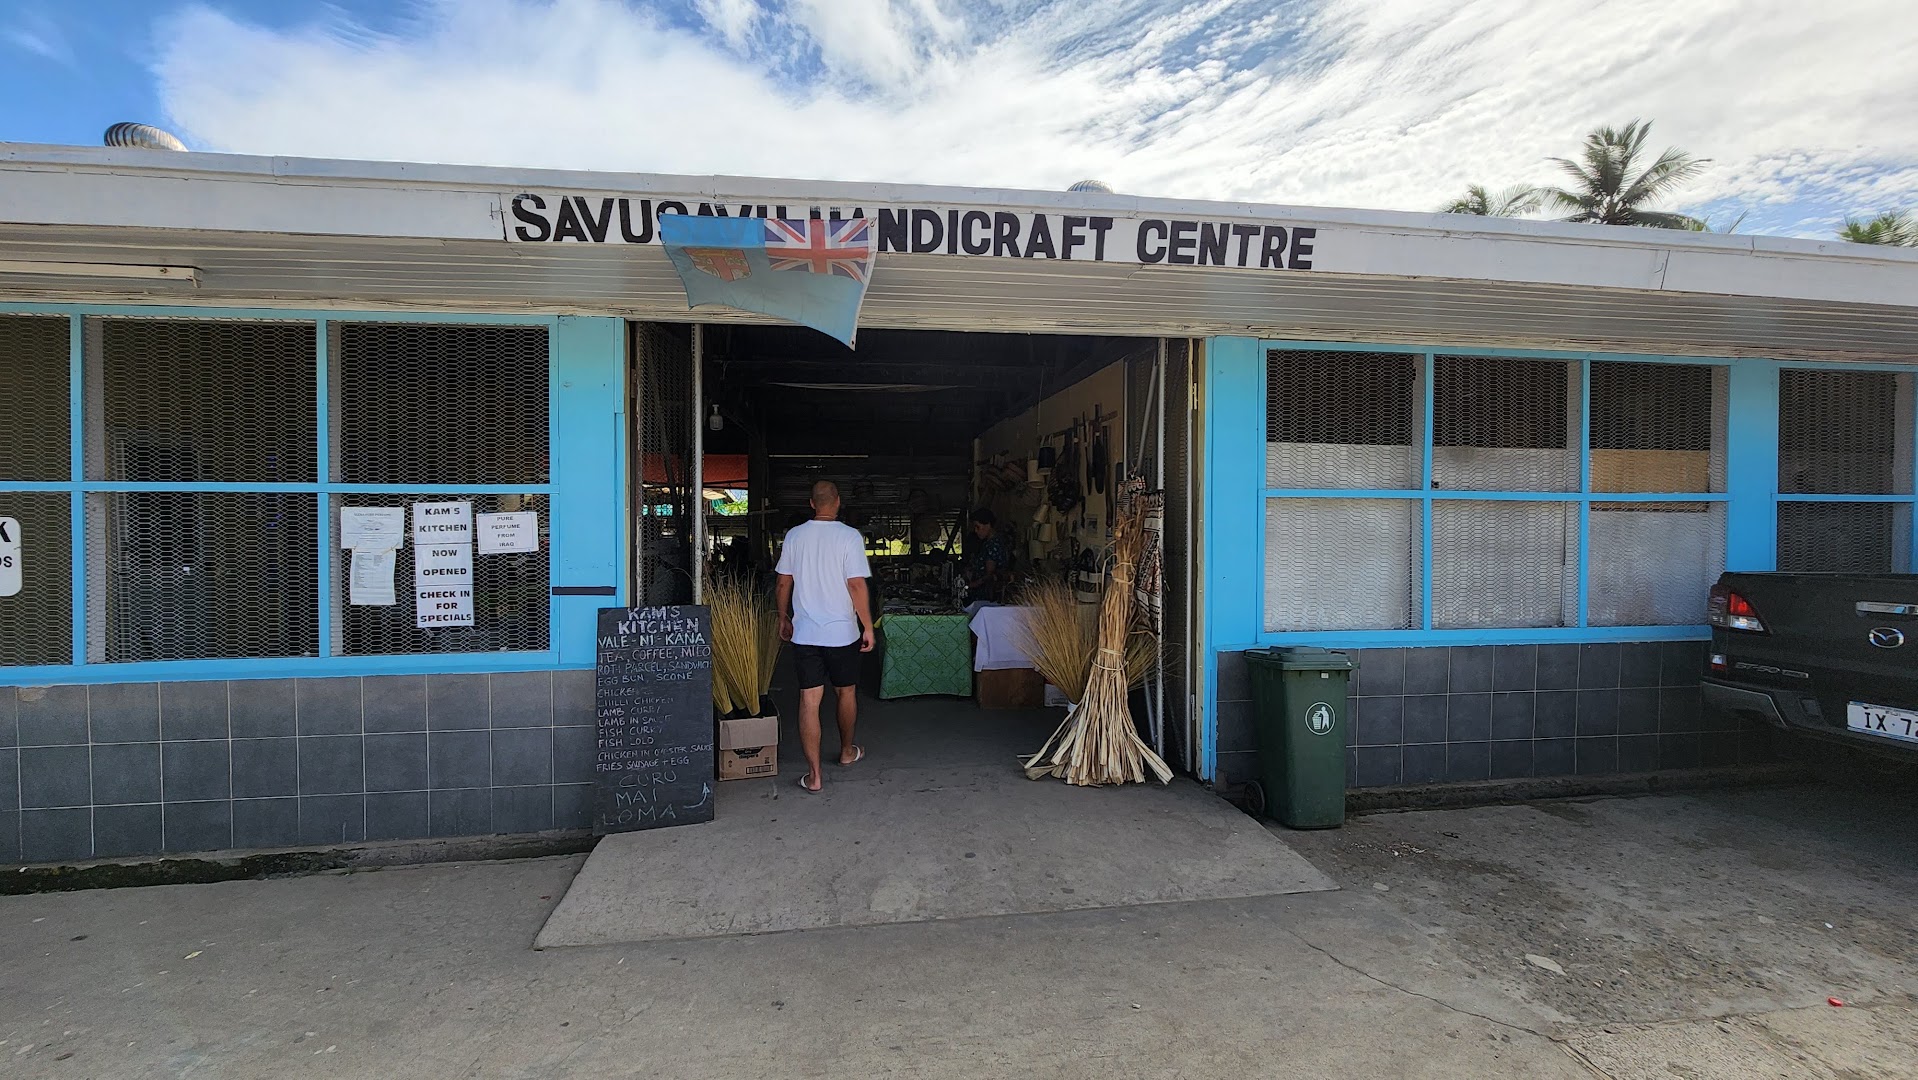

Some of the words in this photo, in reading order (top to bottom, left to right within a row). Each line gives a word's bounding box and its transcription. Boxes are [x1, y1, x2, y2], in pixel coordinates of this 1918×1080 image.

[1136, 219, 1317, 270] CENTRE
[419, 524, 467, 533] KITCHEN
[432, 549, 458, 557] NOW
[422, 568, 467, 576] OPENED
[420, 590, 456, 599] CHECK
[436, 602, 458, 610] FOR
[627, 605, 681, 621] KAM'S
[420, 614, 472, 623] SPECIALS
[617, 617, 700, 635] KITCHEN
[597, 709, 625, 718] LAMB
